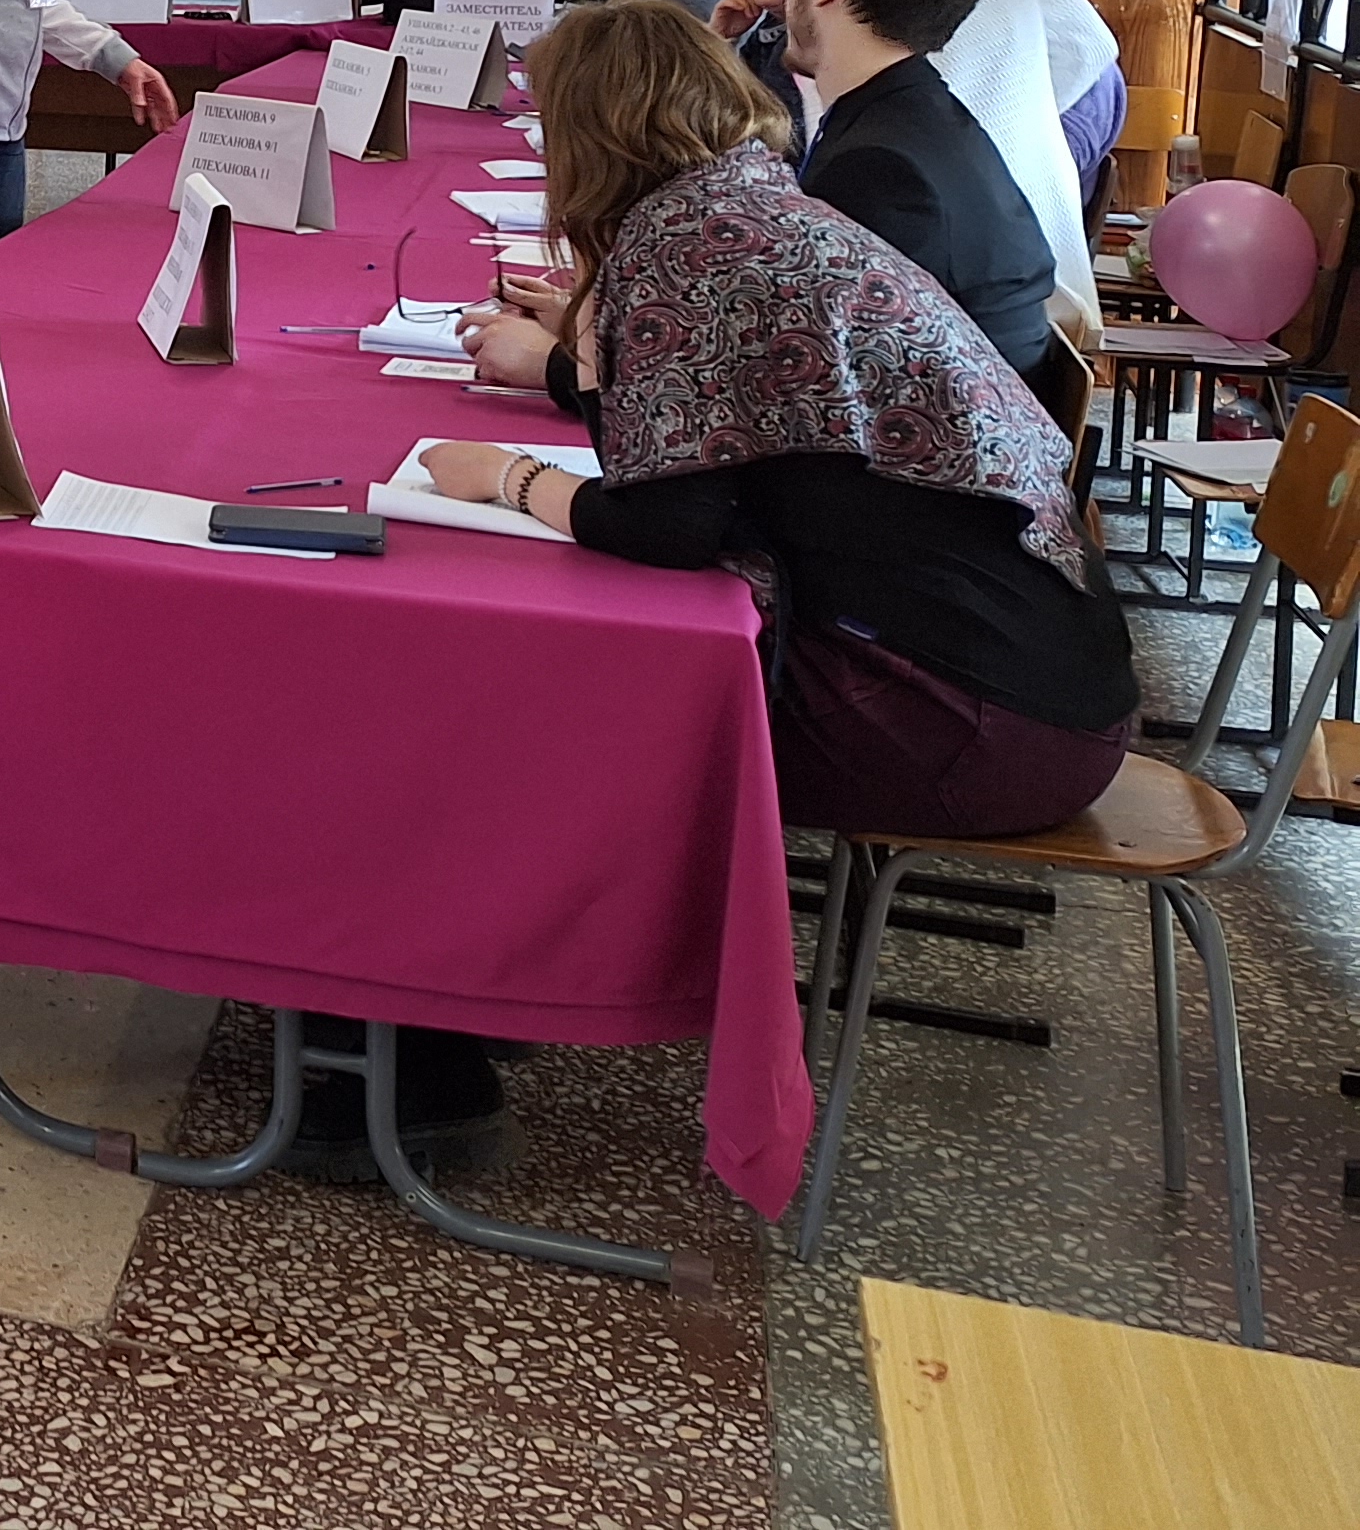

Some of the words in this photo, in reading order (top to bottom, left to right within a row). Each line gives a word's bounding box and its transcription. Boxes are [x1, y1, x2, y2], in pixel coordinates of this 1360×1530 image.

[446, 3, 542, 16] ЗАМЕСТИТЕЛЬ
[204, 105, 267, 124] ПЛЕХАНОВА
[270, 113, 276, 124] 9
[198, 131, 262, 152] ПЛЕХАНОВА
[264, 140, 278, 153] 9/1
[192, 157, 257, 179] ПЛЕХАНОВА
[260, 168, 270, 181] 11
